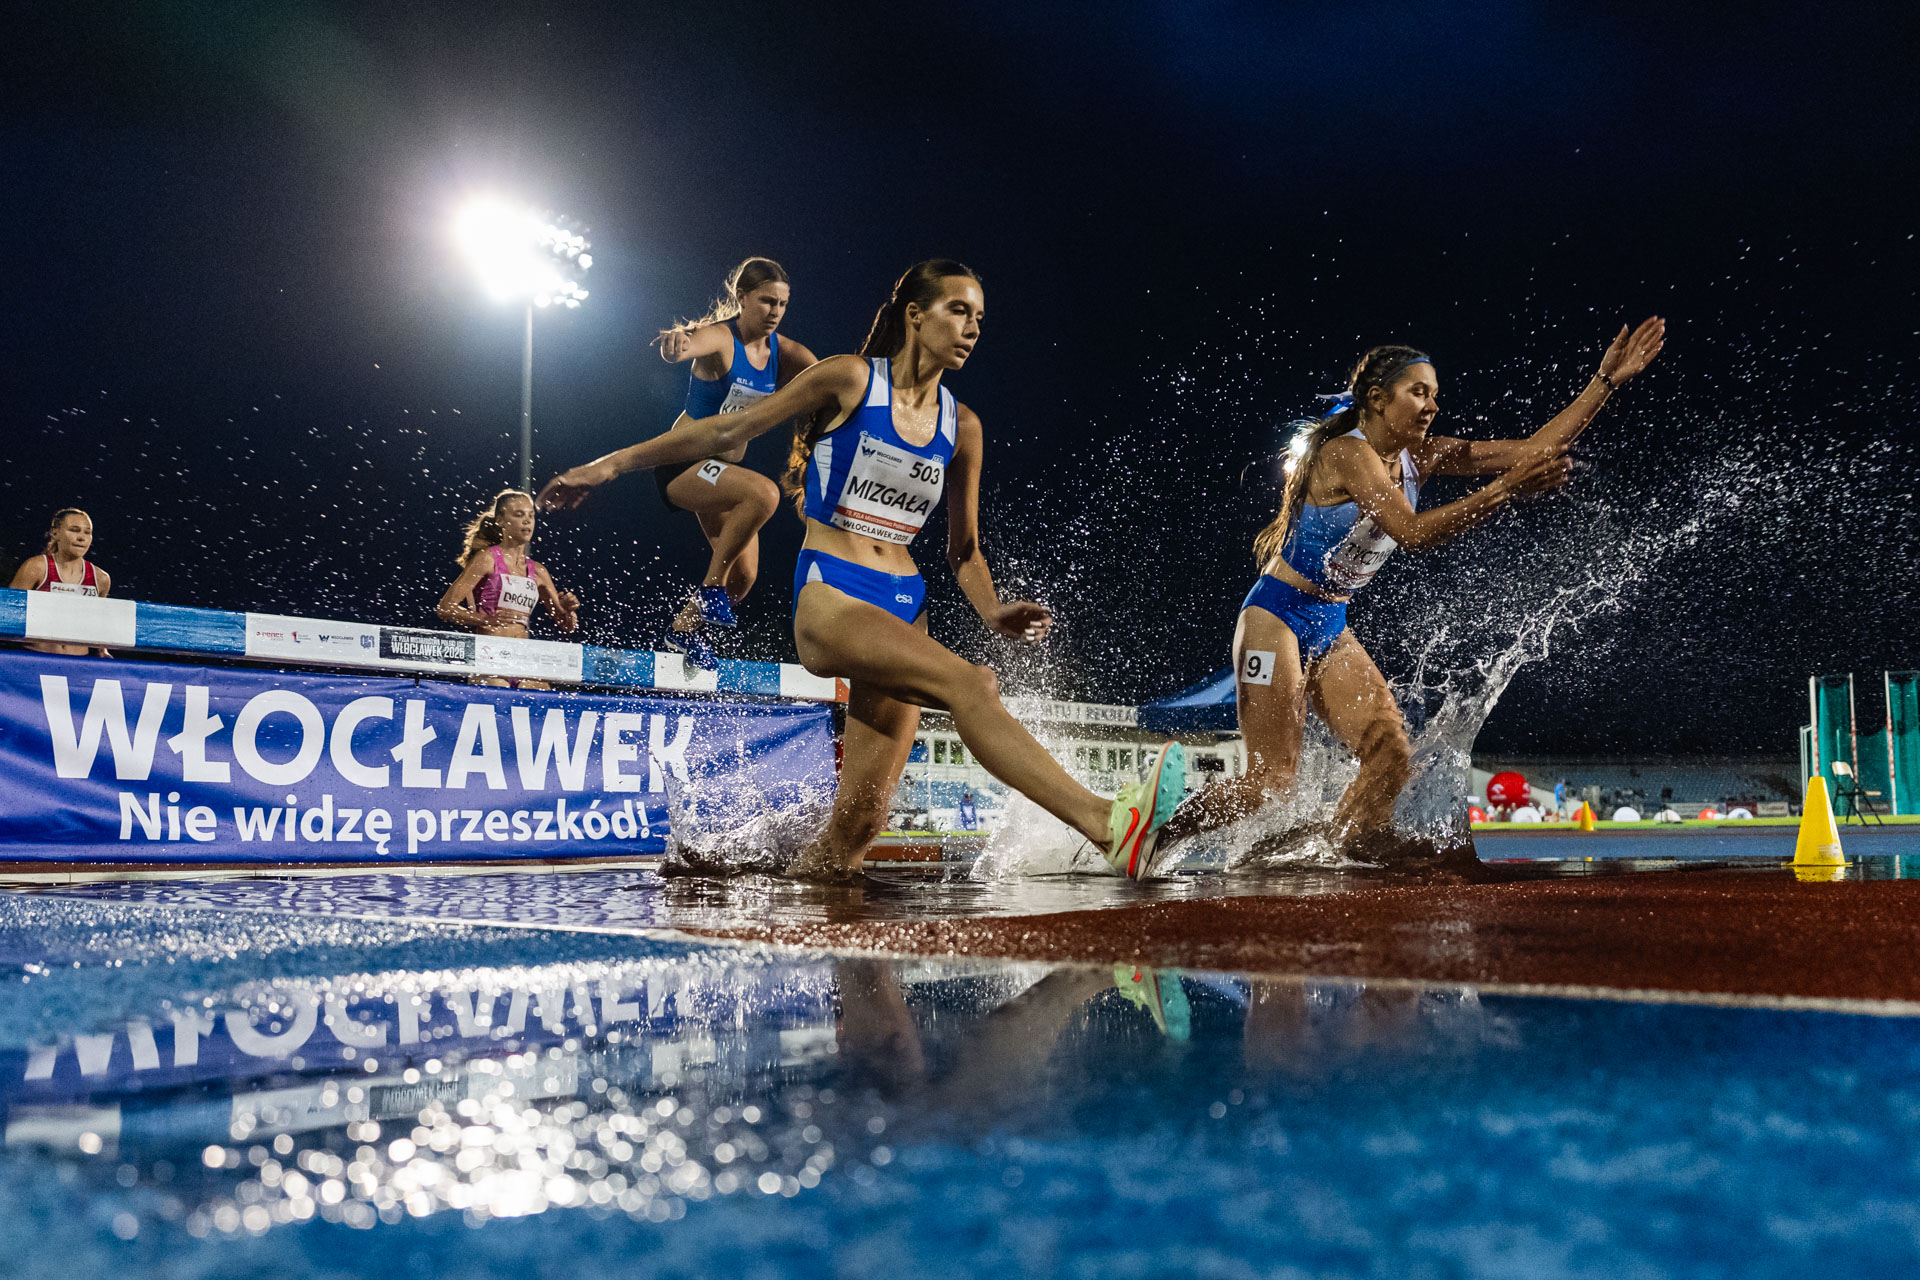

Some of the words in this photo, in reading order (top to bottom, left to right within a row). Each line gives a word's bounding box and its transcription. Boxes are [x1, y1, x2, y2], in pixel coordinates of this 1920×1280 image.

[703, 463, 720, 477] 5
[909, 461, 940, 485] 503
[847, 476, 930, 516] MIZGAŁA
[843, 520, 892, 539] WŁOCŁAWEK
[82, 587, 96, 597] 733
[391, 642, 442, 657] WŁOCŁAWEK
[39, 674, 694, 793] WŁOCŁAWEK
[119, 791, 217, 841] Nie
[233, 794, 393, 855] widzę
[407, 799, 650, 854] przeszkód!
